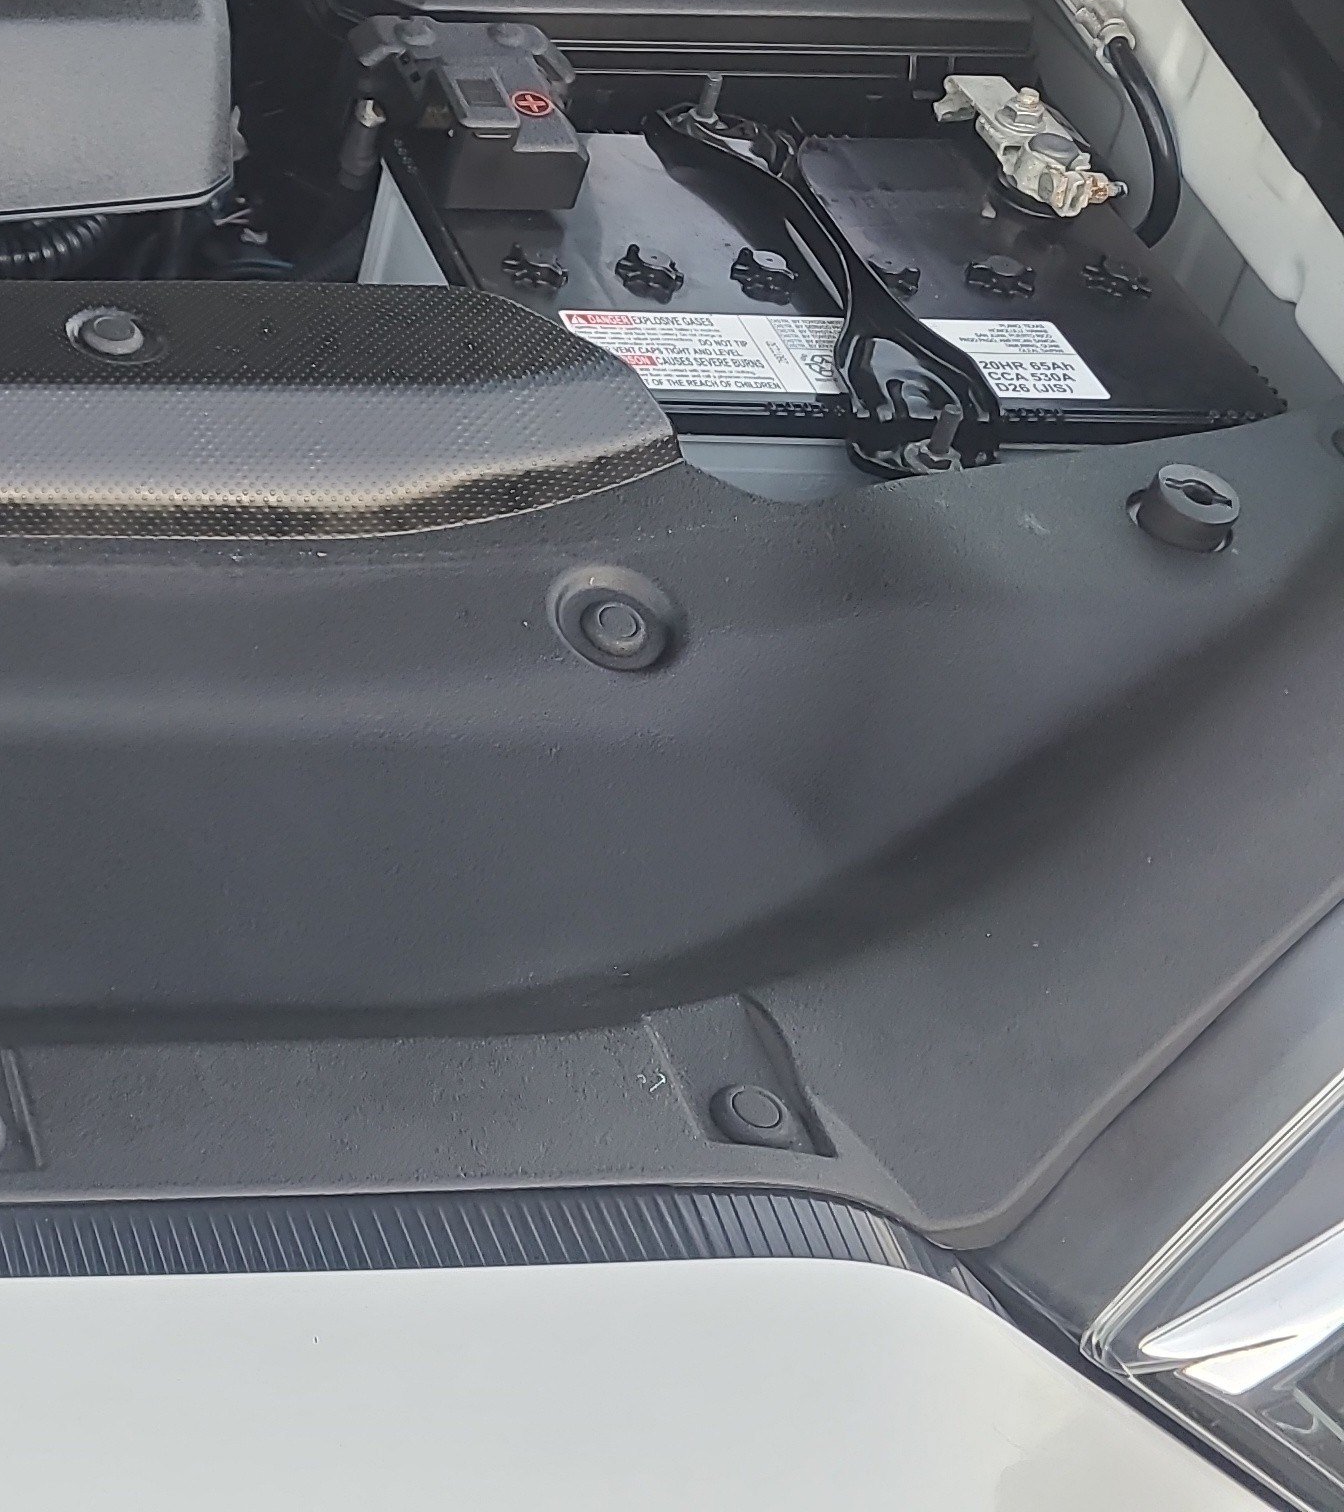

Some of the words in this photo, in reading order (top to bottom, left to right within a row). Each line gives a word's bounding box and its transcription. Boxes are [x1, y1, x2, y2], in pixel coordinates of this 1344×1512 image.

[587, 315, 630, 325] DANGER
[633, 316, 681, 326] EXPLOSIVE
[682, 317, 714, 327] GASES
[735, 340, 748, 348] TIP
[638, 347, 663, 355] CAPS
[693, 348, 713, 356] AND
[715, 349, 744, 357] LEVEL
[657, 357, 693, 367] CAUSES
[695, 358, 732, 368] SEVERE
[731, 358, 764, 368] BURNS
[979, 360, 1026, 370] 20HR
[1029, 361, 1076, 371] 65Ah
[987, 372, 1029, 382] CCA
[1030, 372, 1077, 382] 530A
[666, 379, 685, 387] THE
[686, 379, 718, 388] REACH
[719, 380, 732, 388] OF
[734, 380, 781, 390] CHILDREN
[995, 382, 1031, 393] D26
[1032, 383, 1074, 394] (JIS)
